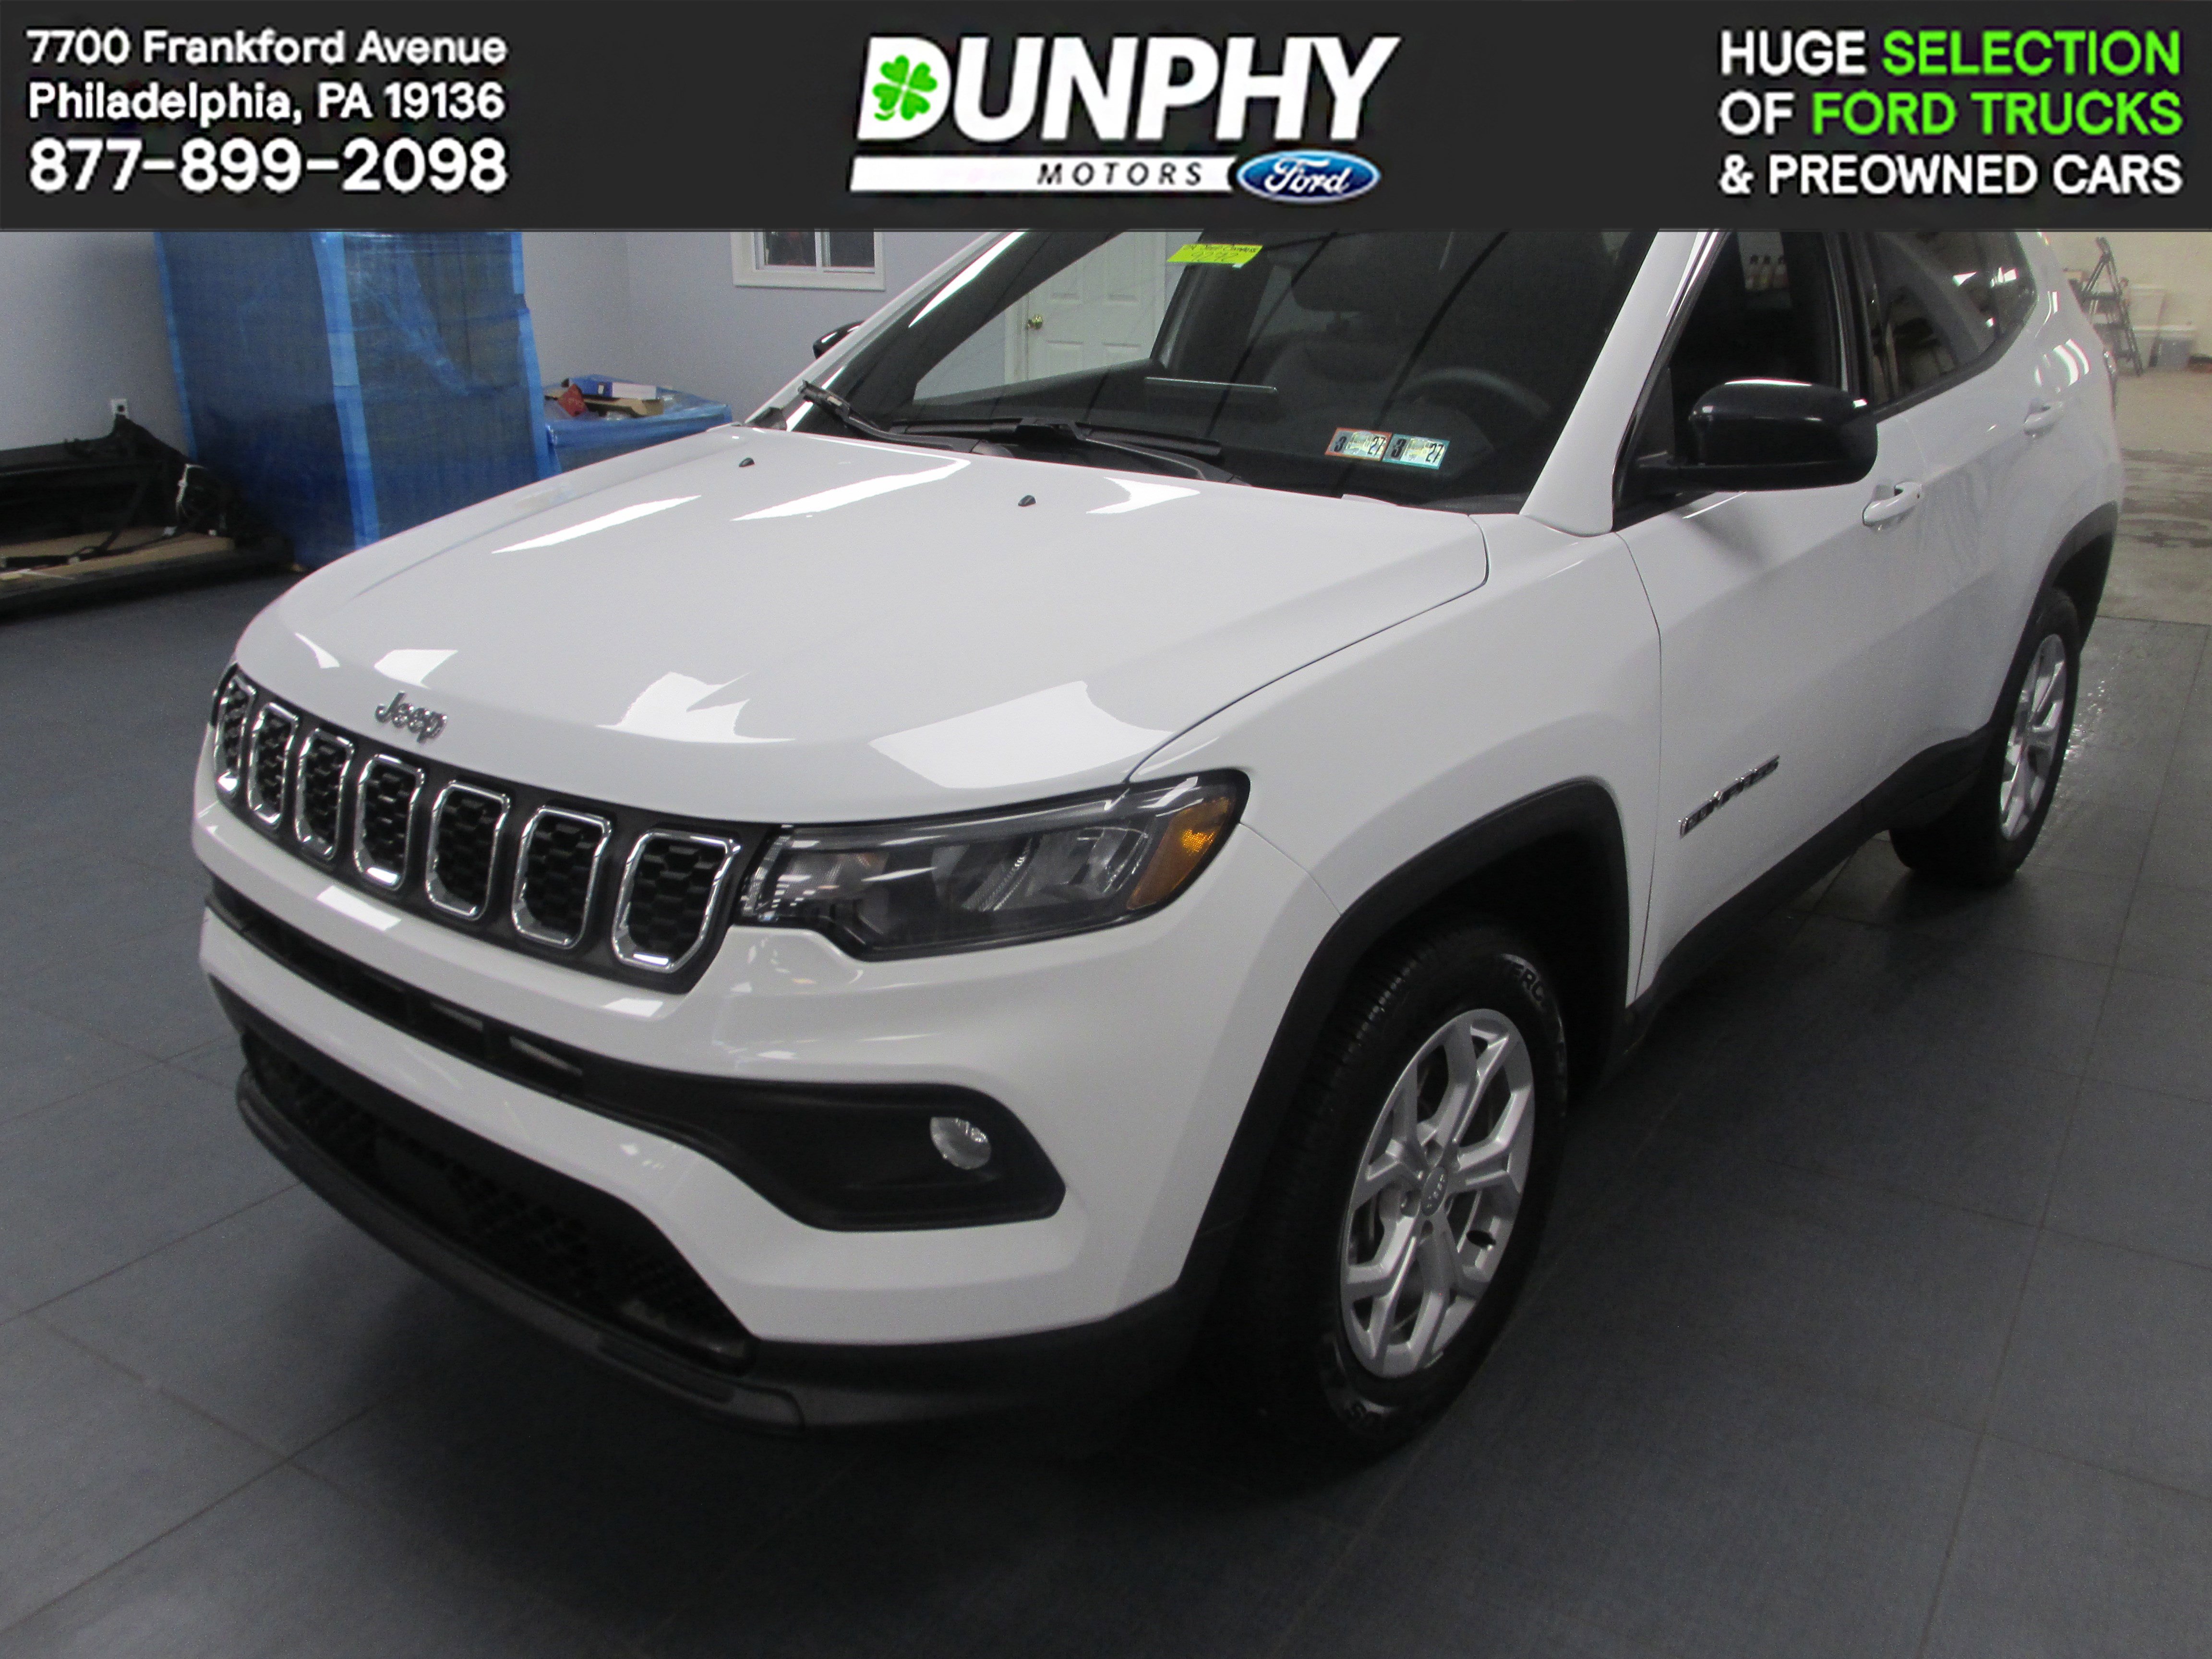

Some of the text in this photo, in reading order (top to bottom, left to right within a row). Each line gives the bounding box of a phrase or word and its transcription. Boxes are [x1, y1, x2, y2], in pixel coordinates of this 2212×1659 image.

[1368, 435, 1386, 455] 27
[1425, 443, 1444, 463] 27
[374, 690, 448, 743] Jeep
